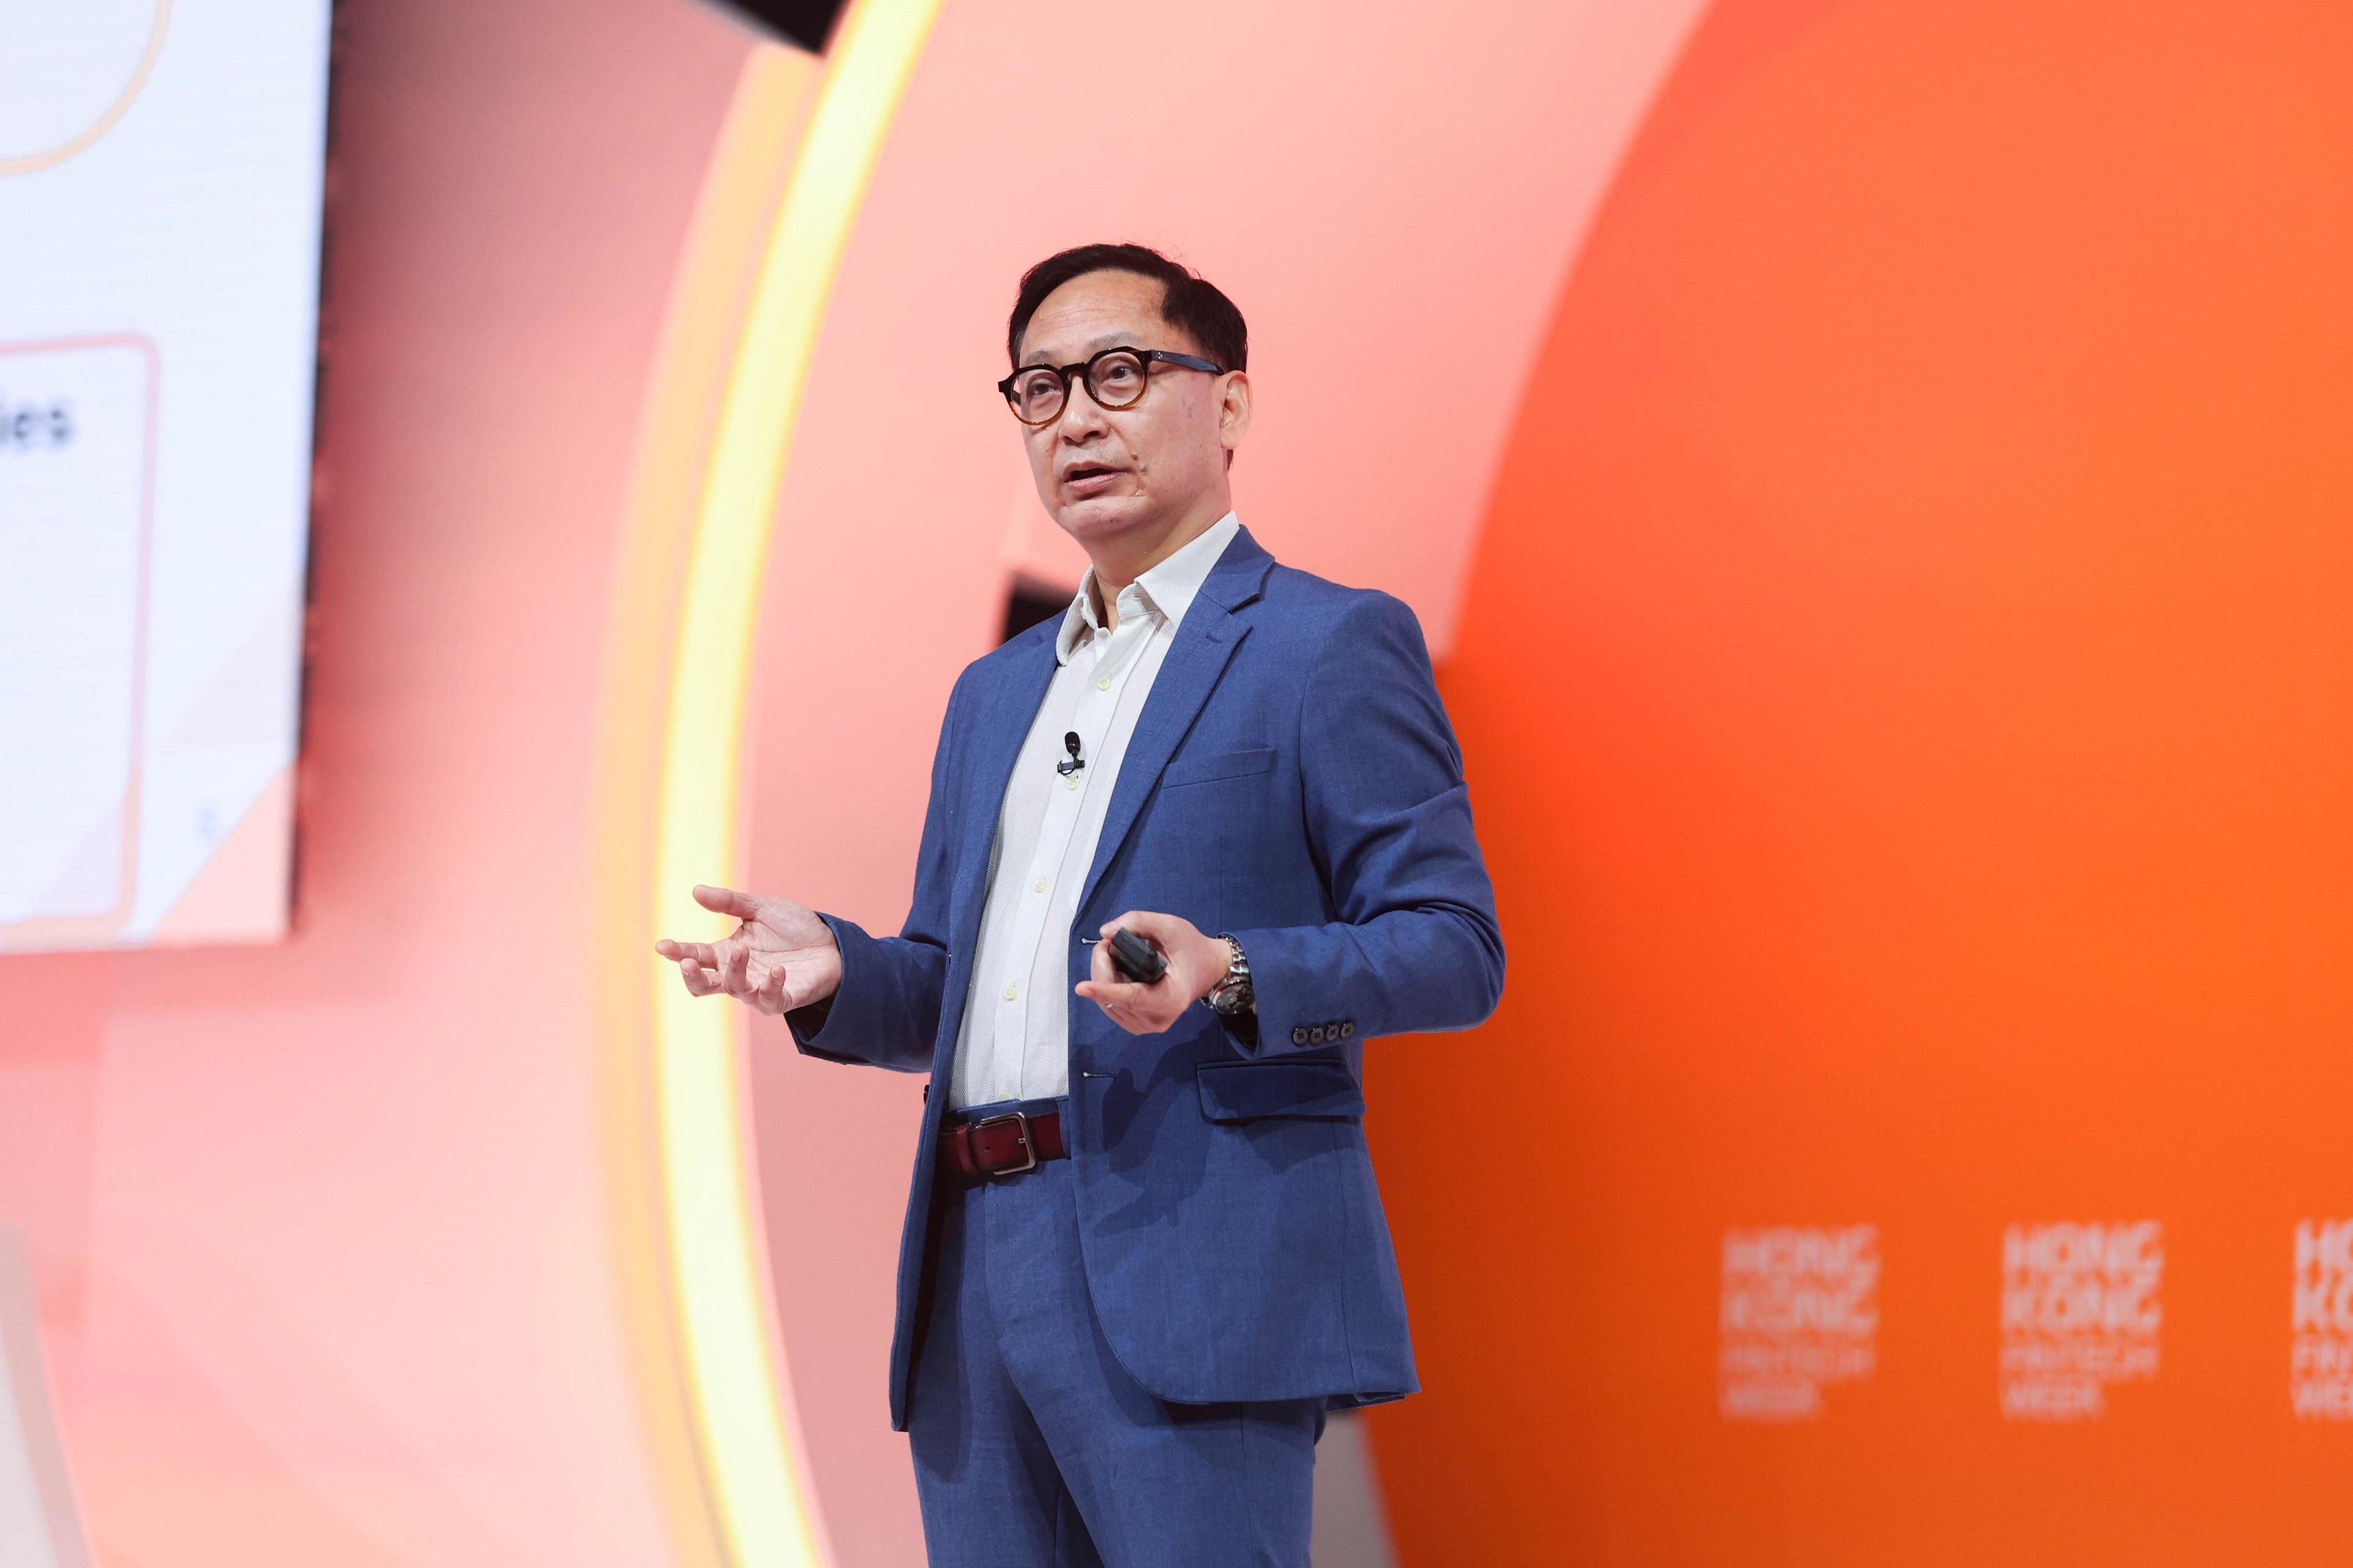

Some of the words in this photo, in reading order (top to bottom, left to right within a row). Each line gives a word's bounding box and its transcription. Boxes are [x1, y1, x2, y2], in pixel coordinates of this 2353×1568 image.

[1723, 1227, 1881, 1276] HONG
[2003, 1223, 2162, 1274] HONG
[1721, 1281, 1879, 1333] KONG
[2002, 1279, 2162, 1331] KONG
[2000, 1385, 2102, 1417] WEEK
